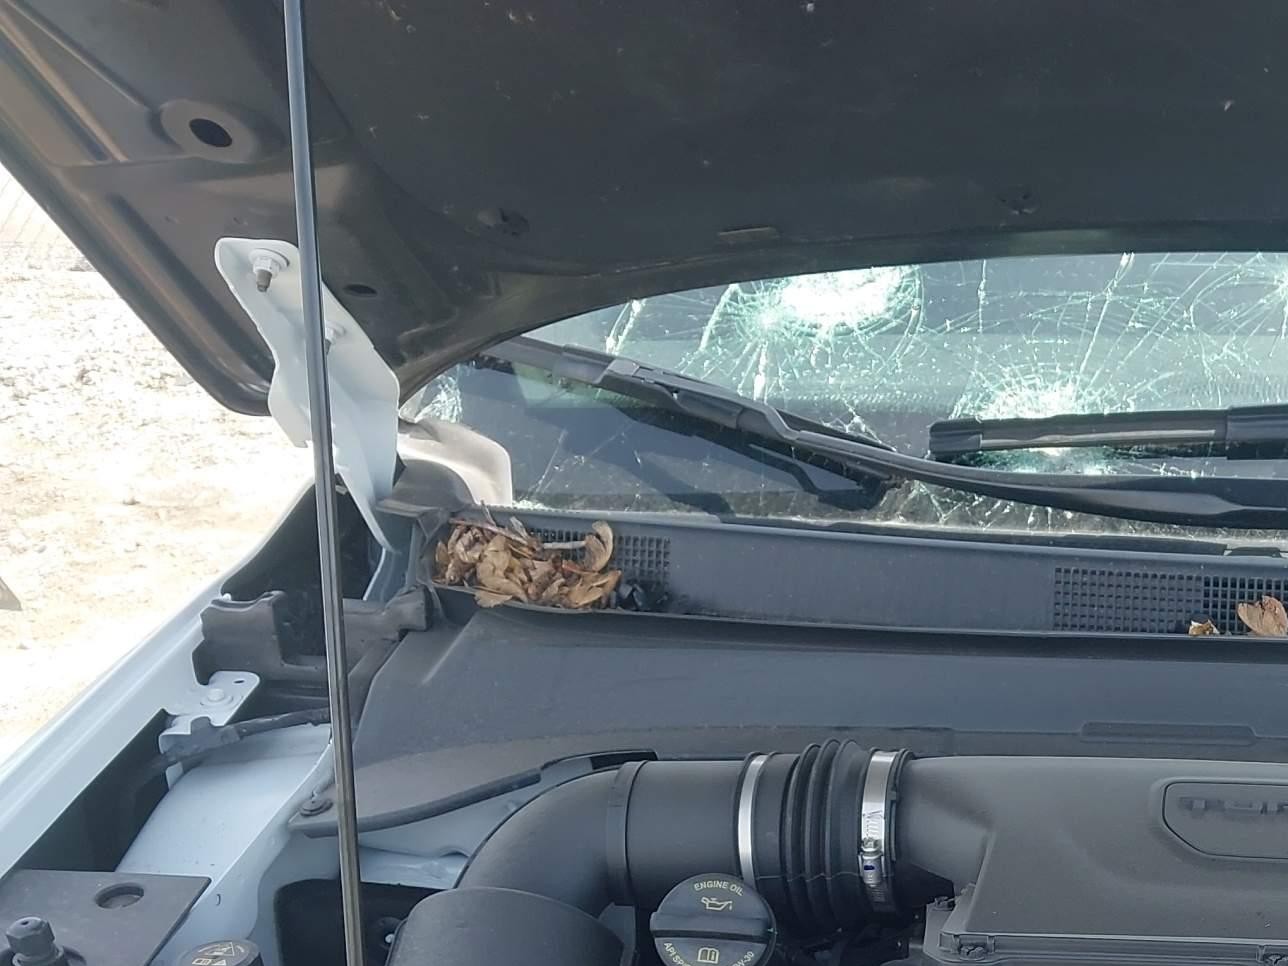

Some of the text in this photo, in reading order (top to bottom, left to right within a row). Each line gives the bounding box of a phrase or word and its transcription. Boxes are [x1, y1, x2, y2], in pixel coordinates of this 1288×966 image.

[694, 881, 744, 896] ENGINE OIL
[664, 942, 676, 956] API
